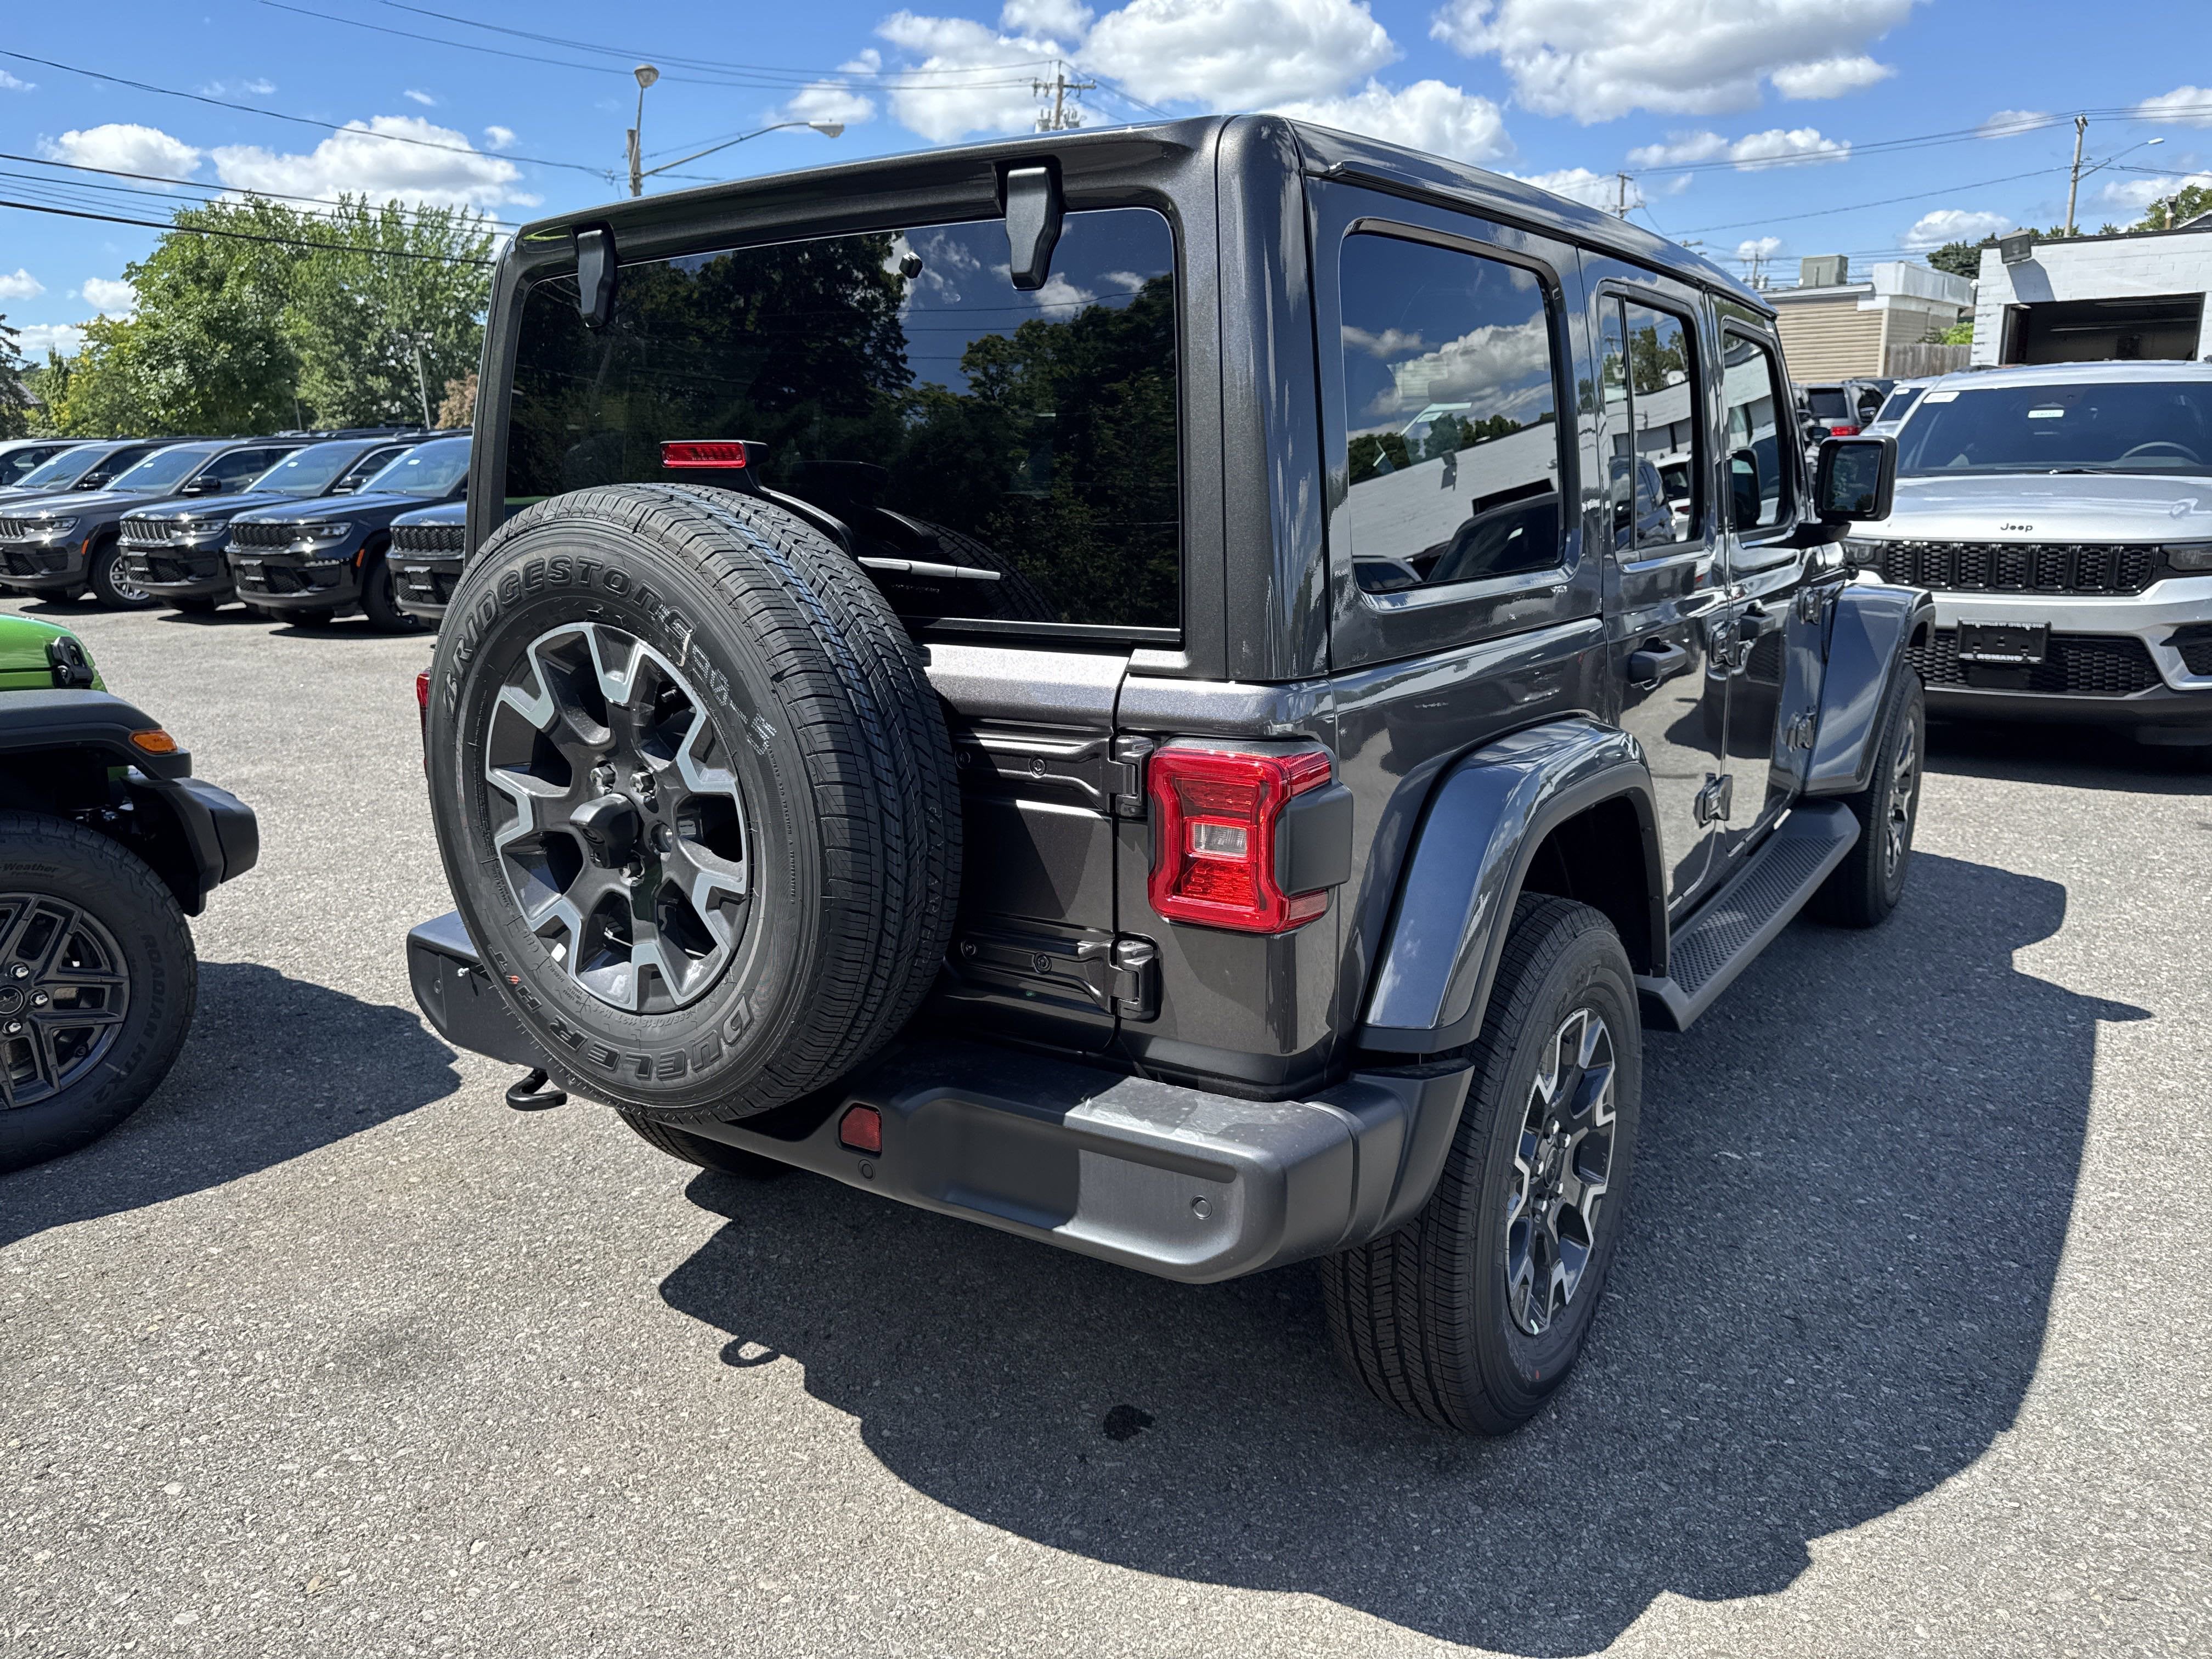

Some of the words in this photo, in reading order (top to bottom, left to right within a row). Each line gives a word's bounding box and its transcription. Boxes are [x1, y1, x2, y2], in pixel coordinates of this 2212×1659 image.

[2000, 523, 2033, 532] Jeep
[442, 554, 697, 720] BRIDGESTONE
[140, 934, 165, 1039] ROADIAN
[549, 992, 754, 1081] DUELER
